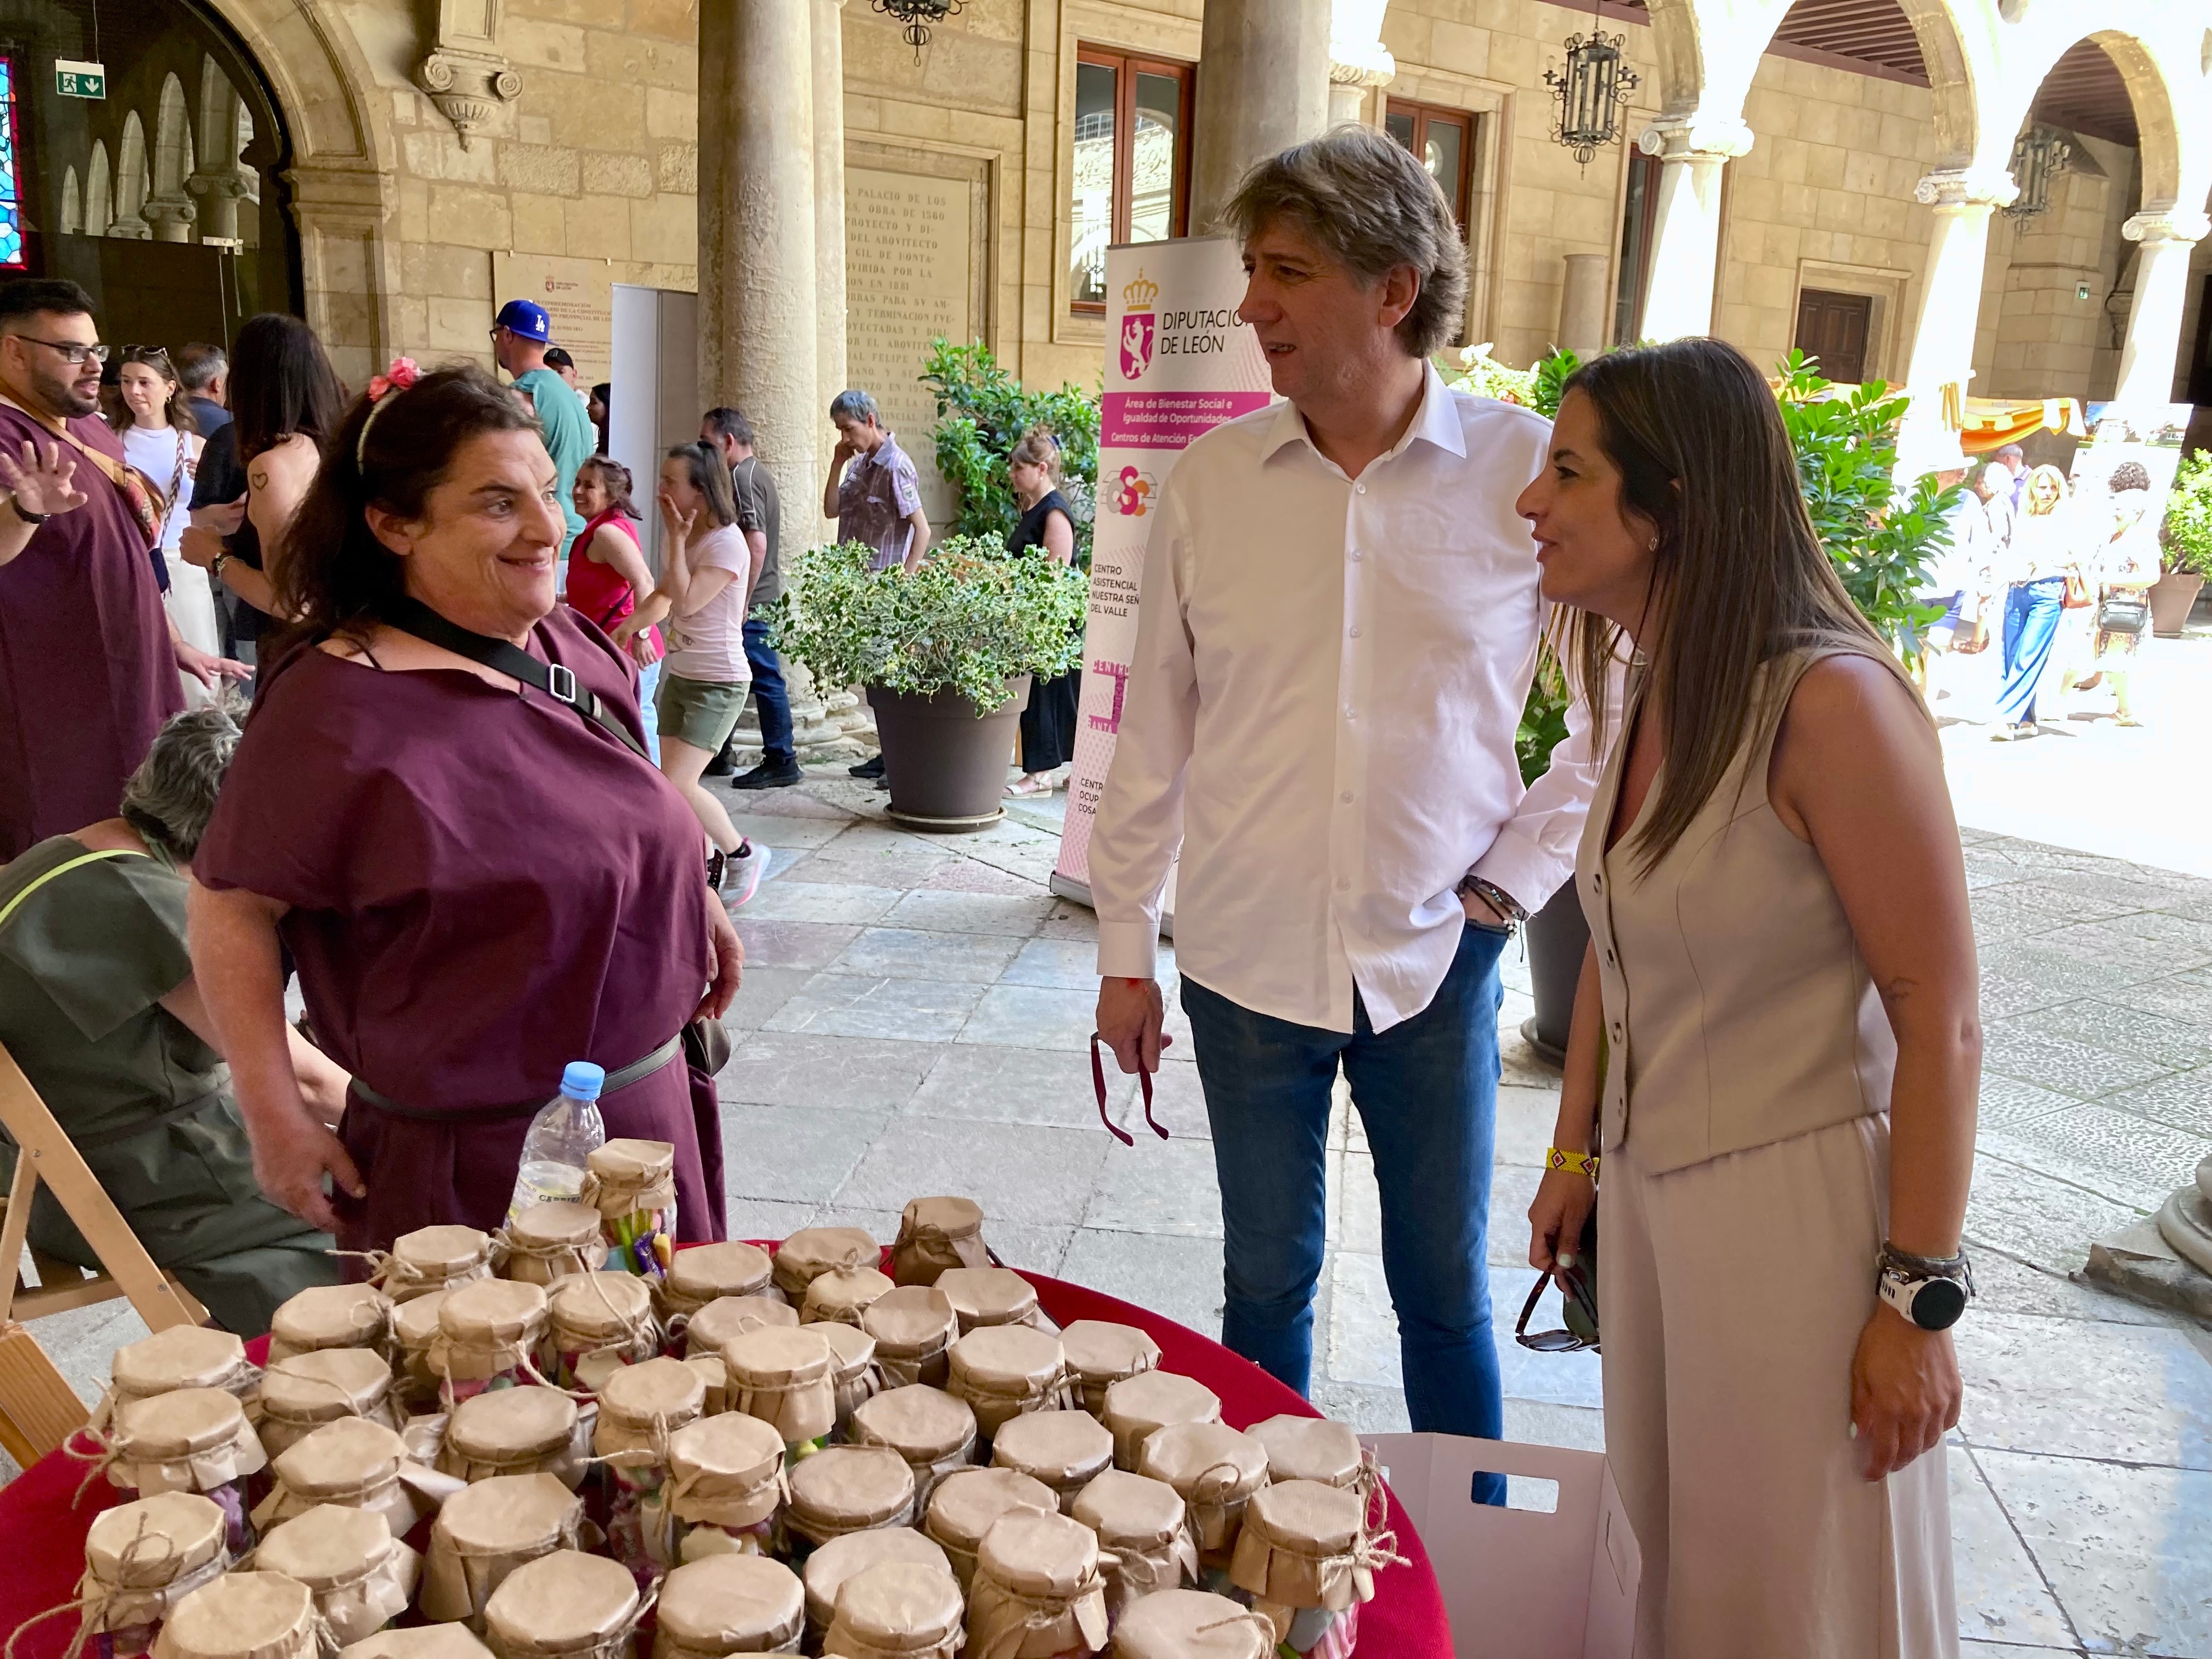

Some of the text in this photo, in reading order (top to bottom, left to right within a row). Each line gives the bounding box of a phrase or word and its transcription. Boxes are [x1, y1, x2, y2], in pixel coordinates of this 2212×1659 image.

[857, 188, 900, 201] PALACIO
[908, 193, 920, 204] DE
[927, 195, 946, 206] LOS
[868, 205, 895, 216] OBRA
[903, 208, 916, 218] DE
[845, 216, 935, 234] PROYECTO Y DI-
[851, 232, 938, 249] DEL ARQVITECTO
[855, 248, 872, 258] GIL
[879, 250, 891, 259] DE
[894, 267, 913, 276] POR
[920, 268, 932, 278] LA
[870, 279, 882, 288] EN
[883, 295, 906, 306] PARA
[914, 298, 926, 306] SV
[855, 308, 861, 317] Y
[867, 308, 929, 321] TERMINACION
[535, 314, 545, 332] LA
[913, 327, 918, 335] Y
[867, 338, 879, 347] EL
[1161, 330, 1224, 354] DE LEÓN
[872, 353, 909, 364] FELIPE
[885, 369, 891, 377] Y
[902, 369, 914, 379] SE
[889, 384, 901, 392] EN
[1125, 397, 1233, 409] Área de Bienestar Social e
[1123, 412, 1158, 424] Igualdad
[1159, 413, 1169, 423] de
[1111, 432, 1139, 443] Centros
[1140, 433, 1151, 443] de
[1152, 432, 1186, 444] Atención
[1094, 564, 1122, 575] CENTRO
[1093, 577, 1137, 591] ASISTENCIAL
[1092, 590, 1124, 603] NUESTRA
[1091, 603, 1128, 617] DEL VALLE
[1081, 778, 1103, 791] CENTR
[1080, 791, 1099, 803] OCUP
[1079, 803, 1096, 815] COSA
